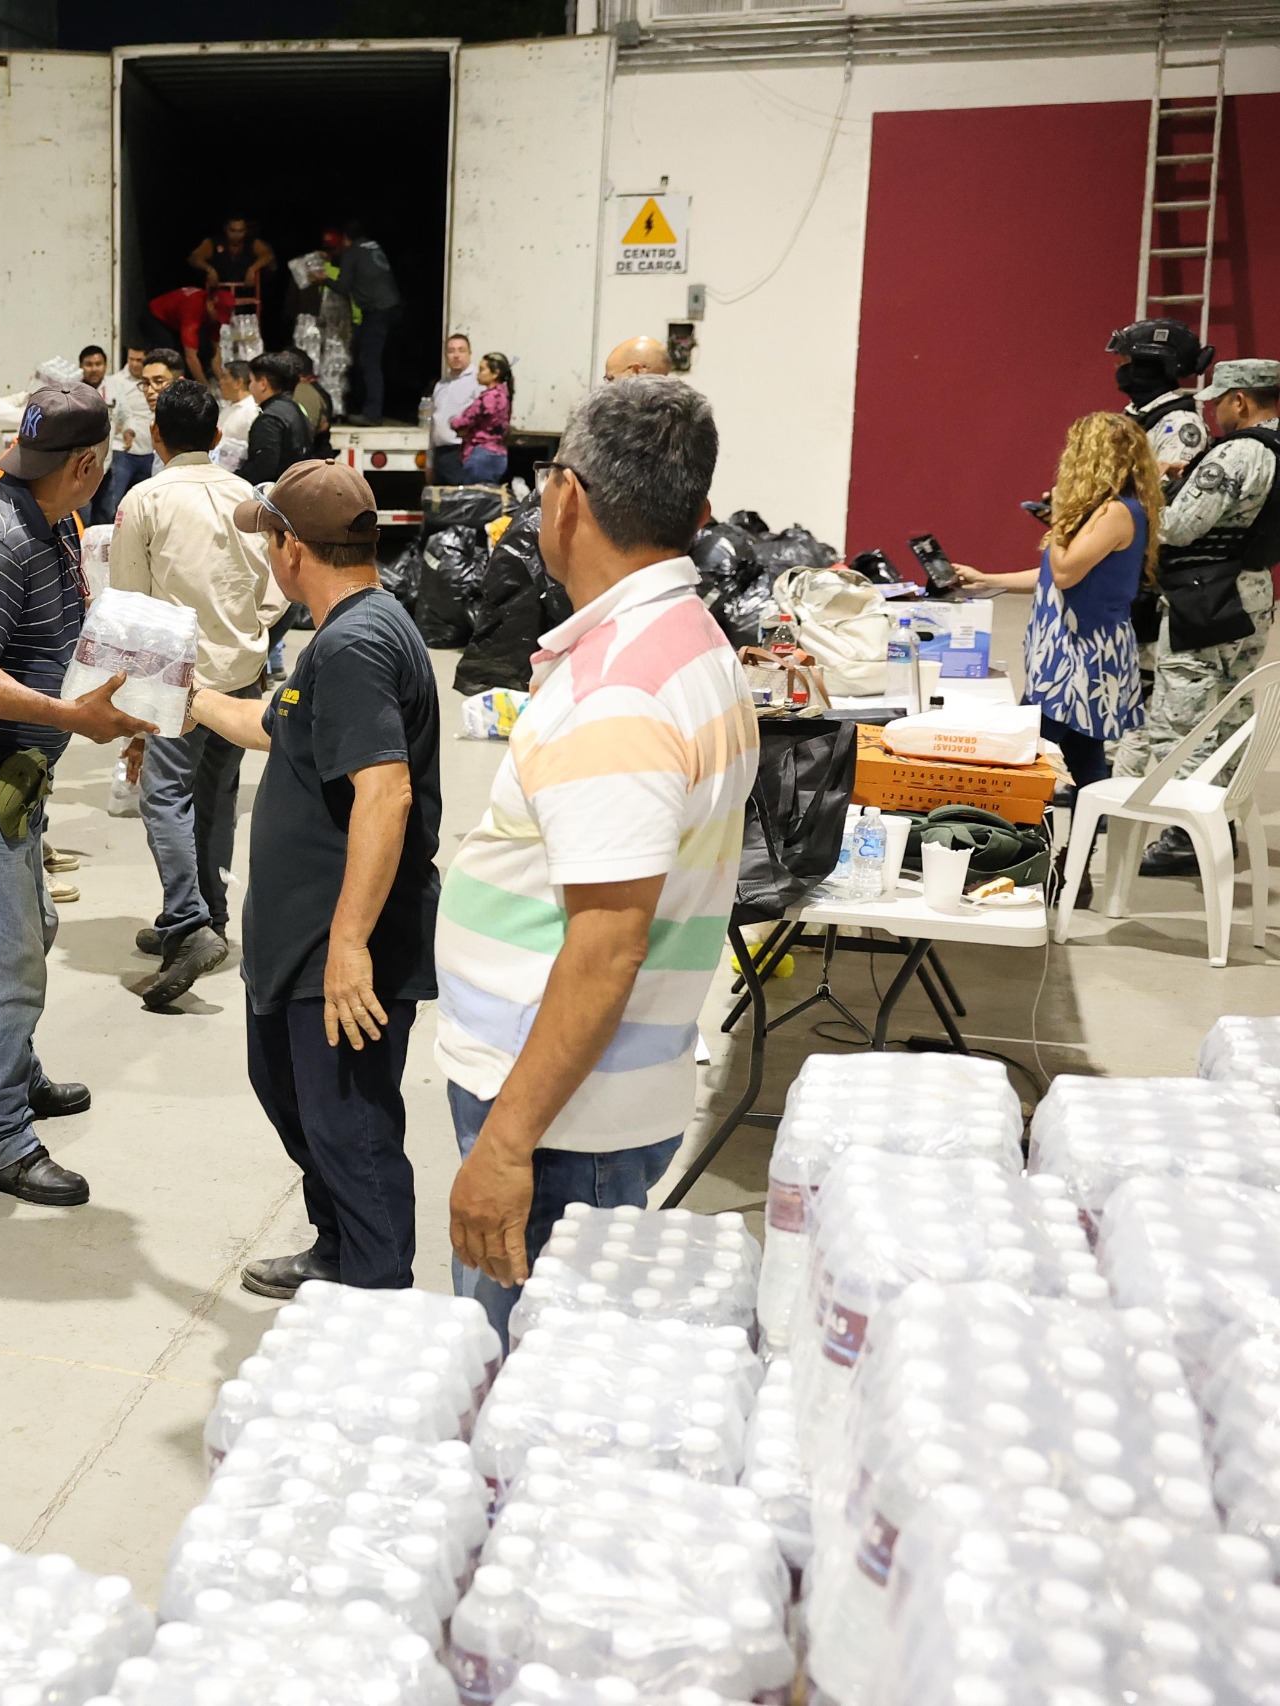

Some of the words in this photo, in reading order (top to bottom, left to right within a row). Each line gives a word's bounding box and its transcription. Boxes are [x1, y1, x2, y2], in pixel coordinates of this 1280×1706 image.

[623, 248, 676, 259] CENTRO
[616, 261, 633, 271] DE
[638, 261, 682, 271] CARGA
